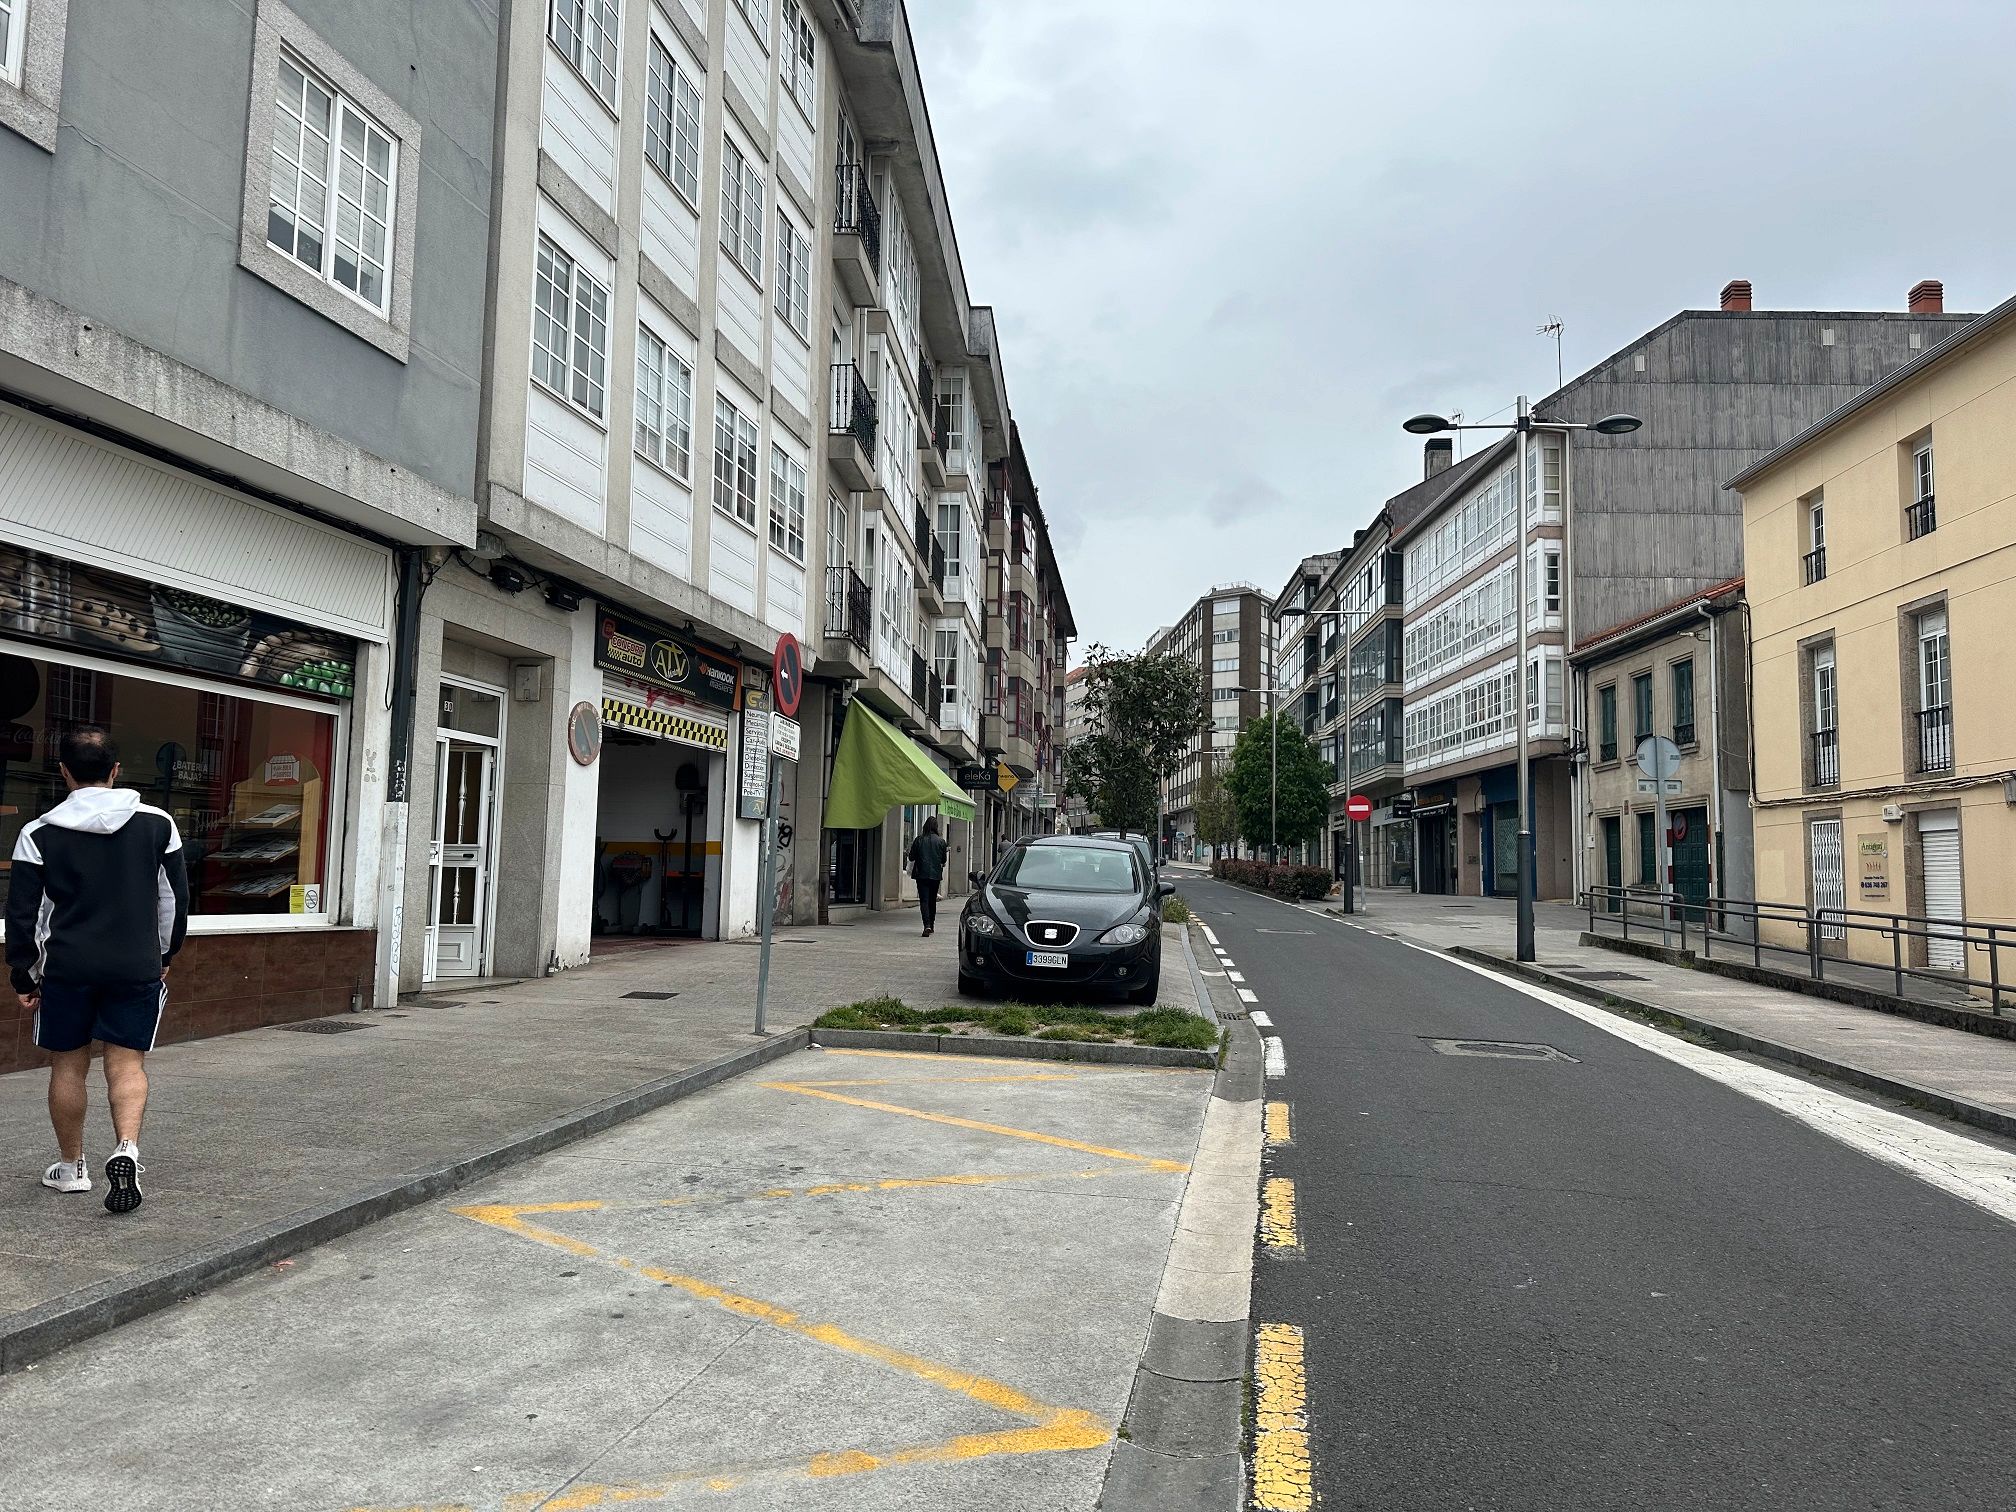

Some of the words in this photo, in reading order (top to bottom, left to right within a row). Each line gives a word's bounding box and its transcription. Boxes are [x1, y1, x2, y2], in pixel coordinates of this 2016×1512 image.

[612, 635, 644, 657] CONFORT
[621, 653, 642, 666] auto
[709, 681, 734, 694] masters
[178, 770, 202, 782] BAJA?
[964, 769, 991, 780] eleKá
[1033, 955, 1067, 965] 3399GLN
